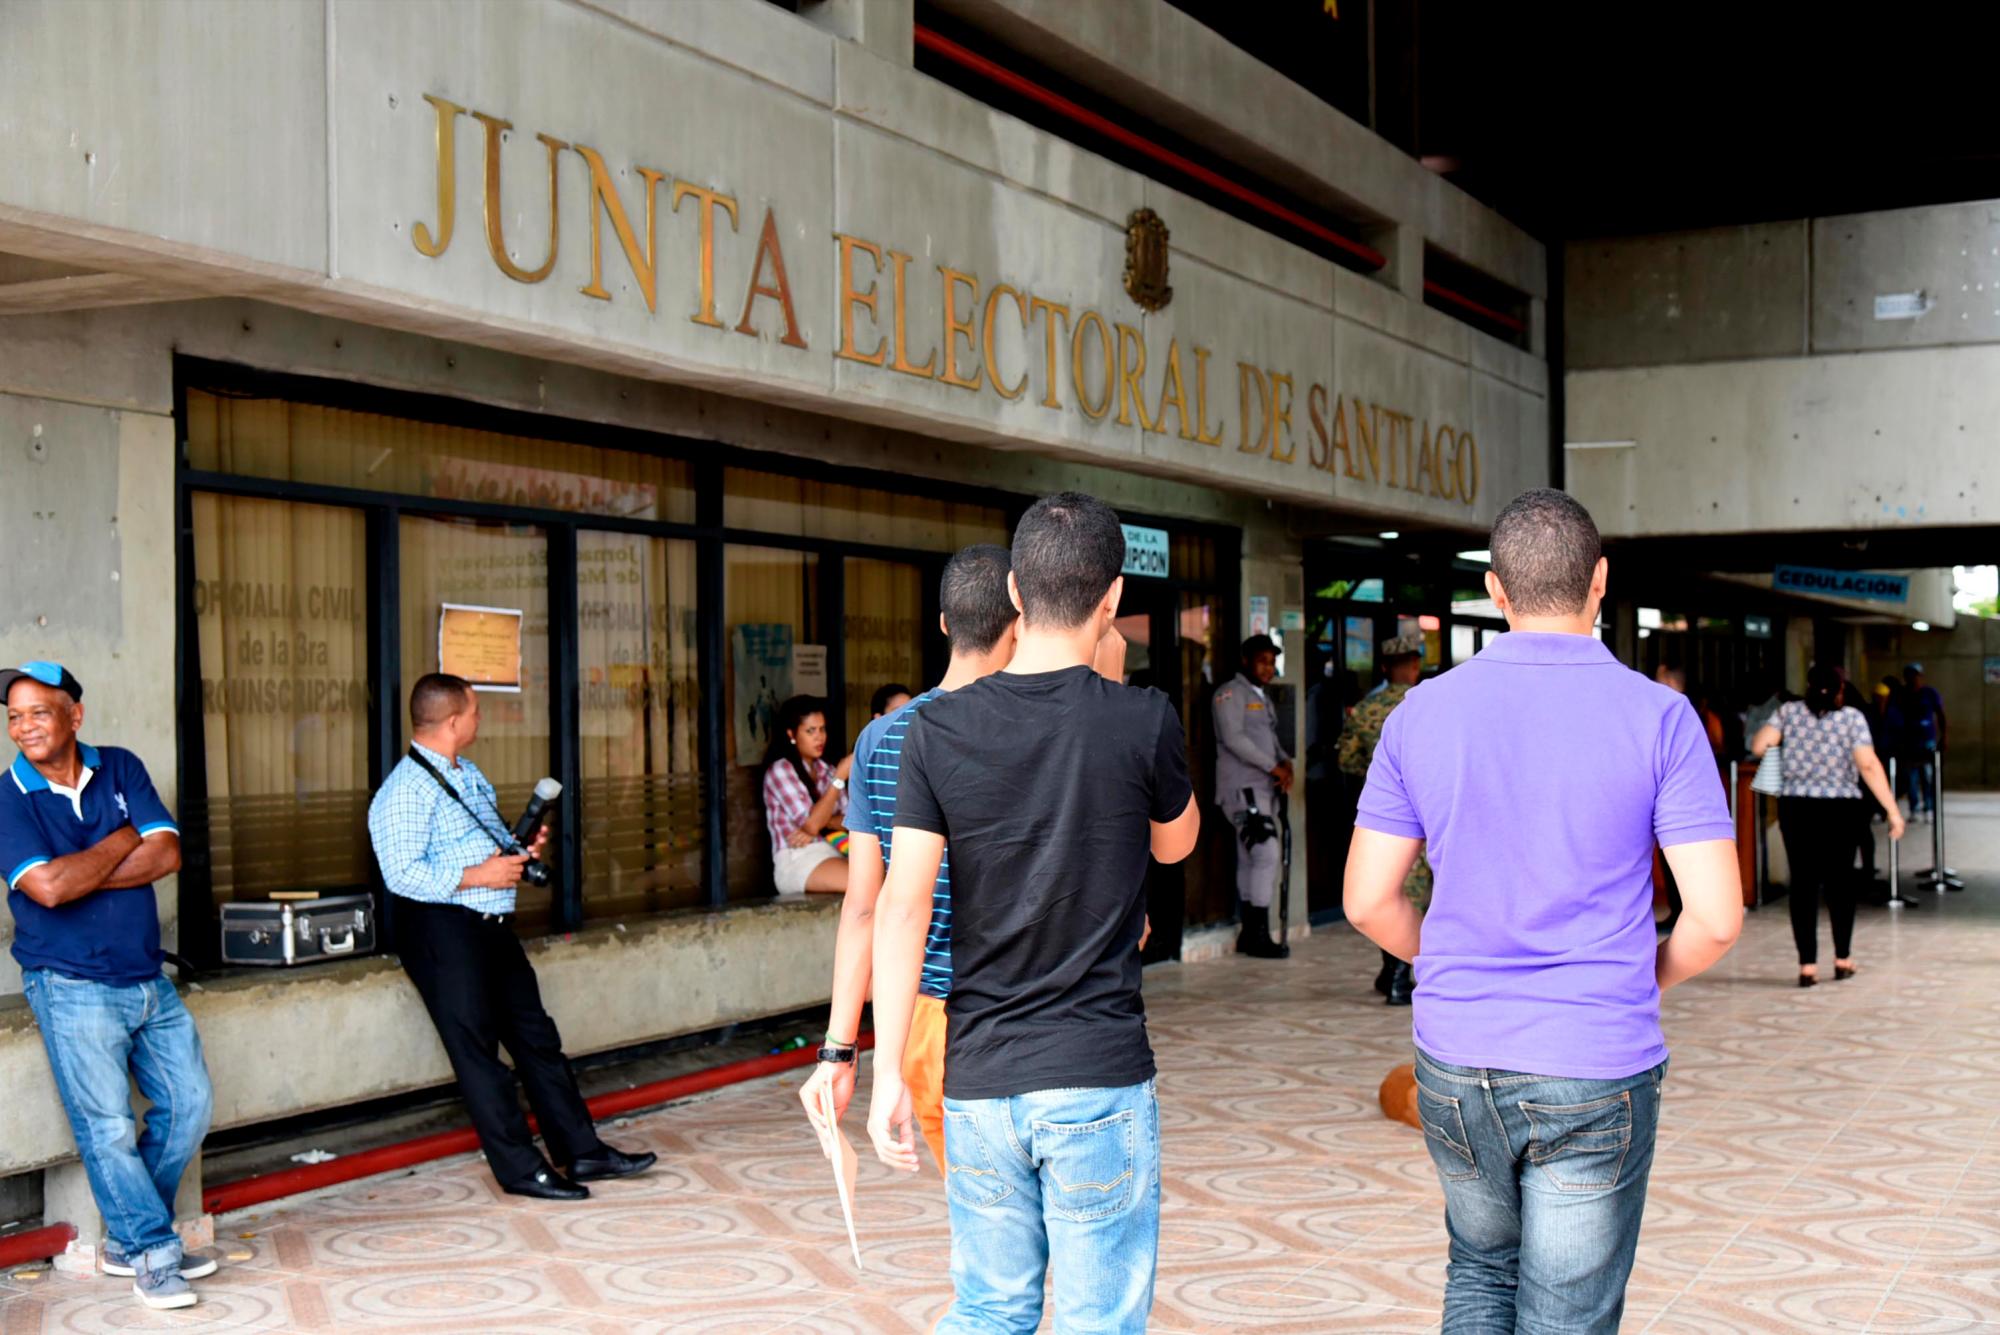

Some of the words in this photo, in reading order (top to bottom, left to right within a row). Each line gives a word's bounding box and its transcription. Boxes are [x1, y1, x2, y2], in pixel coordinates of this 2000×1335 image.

[412, 93, 808, 350] JUNTA
[832, 232, 1224, 447] ELECTORAL
[1237, 361, 1296, 464] DE
[1307, 381, 1480, 505] SANTIAGO
[1144, 533, 1158, 545] LA
[308, 585, 361, 622] CIVIL
[238, 631, 265, 666] de
[271, 632, 289, 666] la
[295, 632, 328, 667] 3ra
[185, 676, 376, 716] IRCUNSCRIPCION
